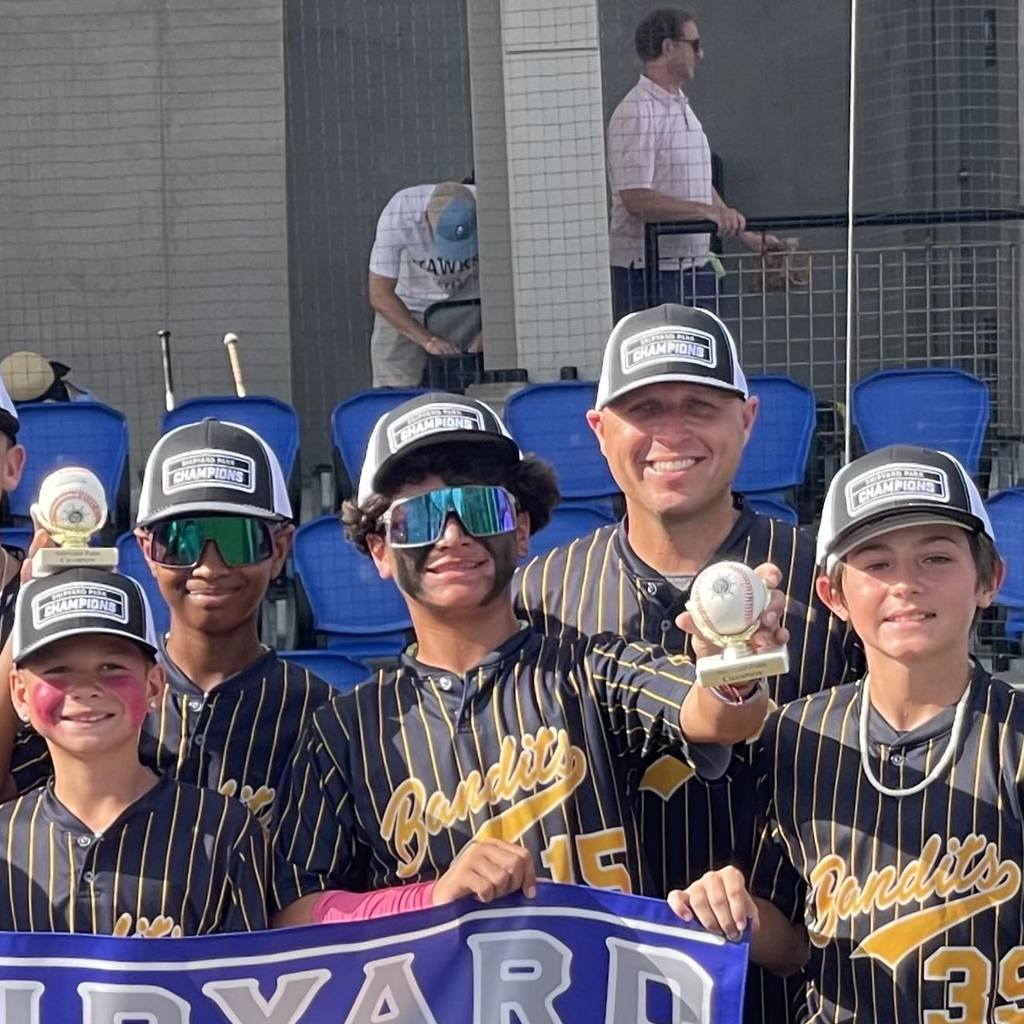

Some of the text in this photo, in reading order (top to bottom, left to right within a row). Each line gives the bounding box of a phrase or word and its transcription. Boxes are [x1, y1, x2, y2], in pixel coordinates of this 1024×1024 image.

[632, 343, 704, 361] CHAMPIONS
[400, 416, 473, 442] CHAMPIONS
[173, 466, 244, 484] CHAMPIONS
[857, 480, 935, 506] CHAMPIONS
[45, 597, 117, 618] CHAMPIONS
[380, 726, 587, 878] Bandits
[540, 826, 632, 896] 15
